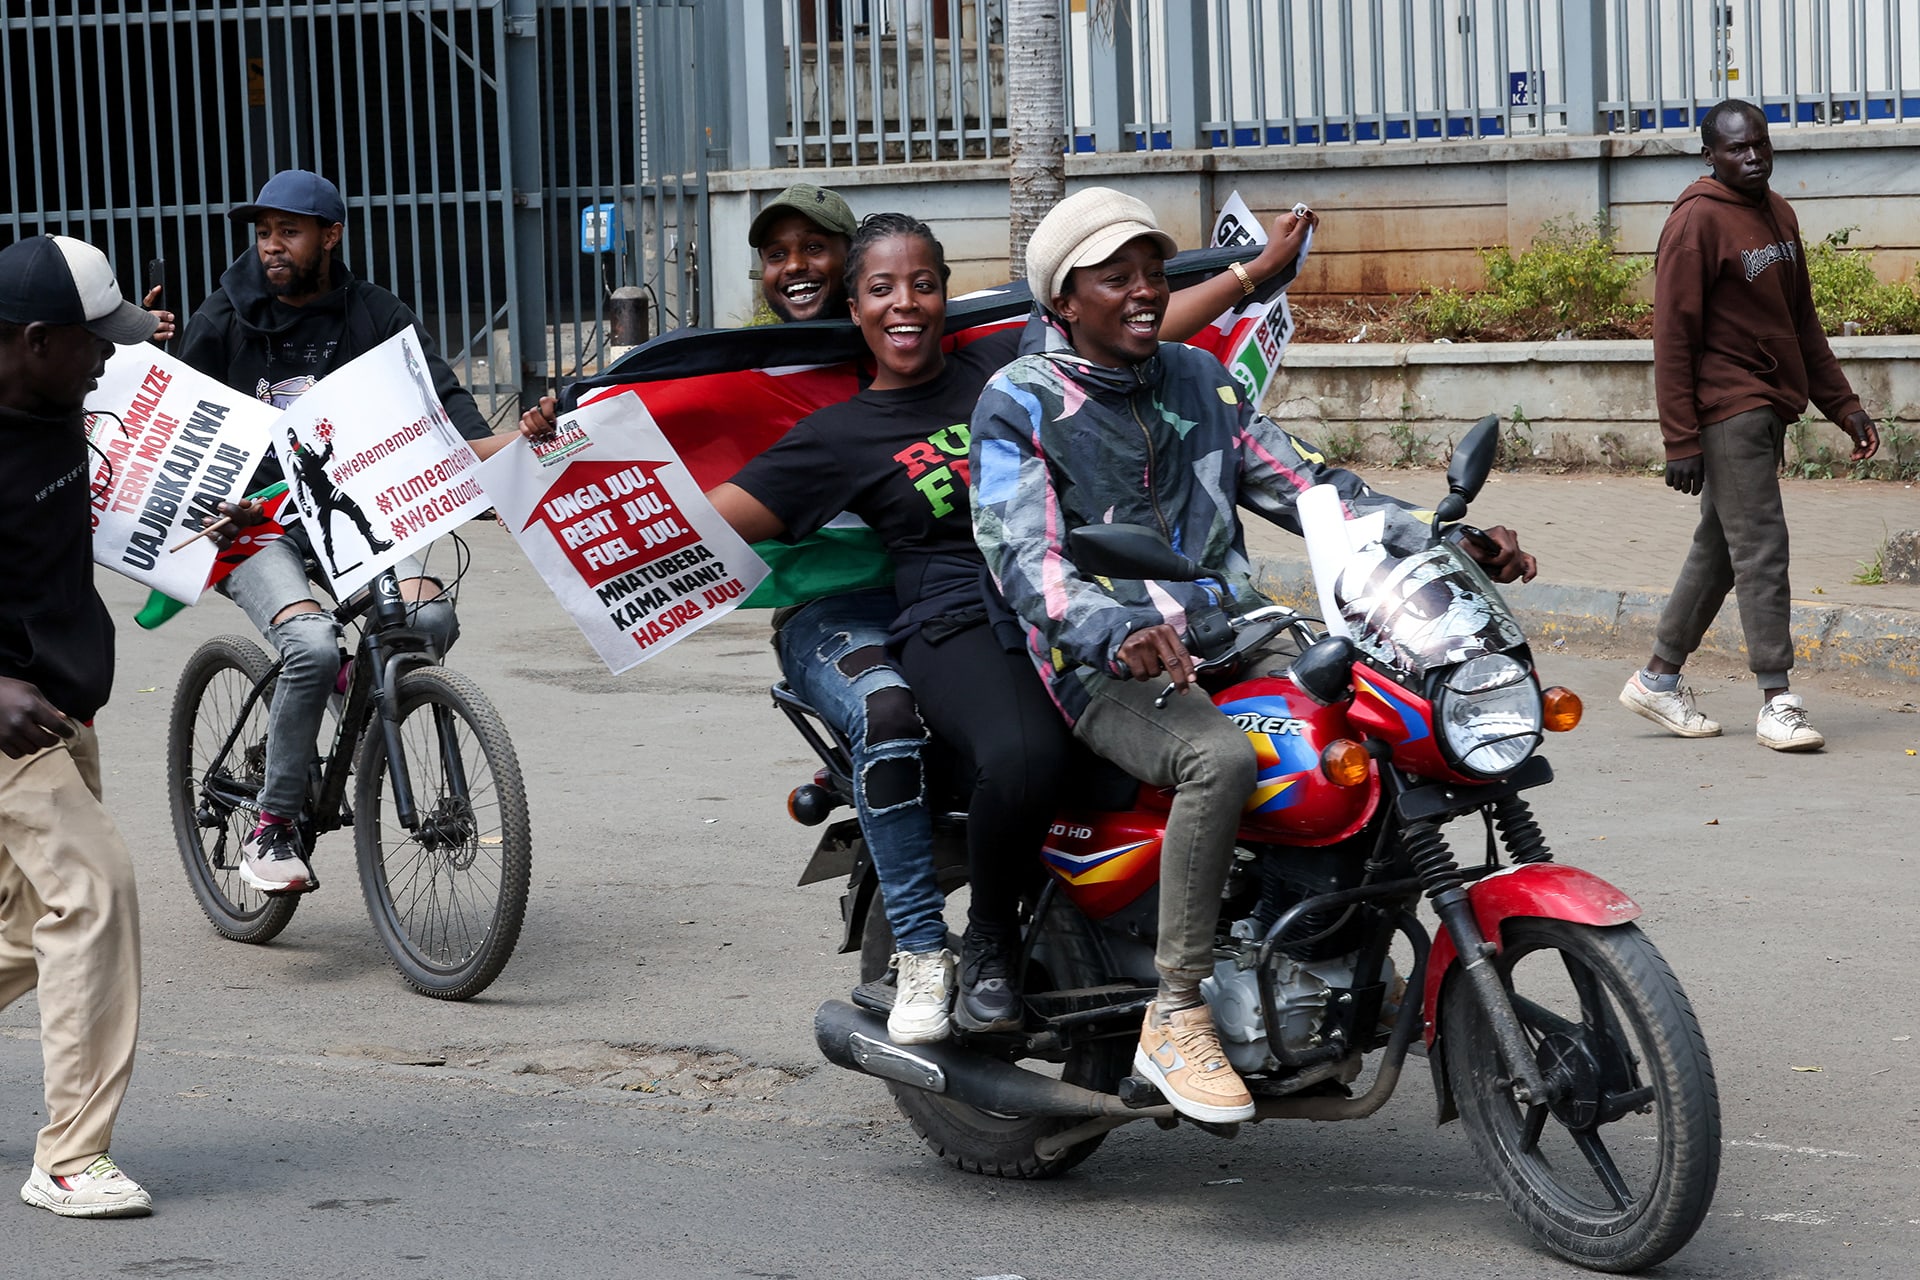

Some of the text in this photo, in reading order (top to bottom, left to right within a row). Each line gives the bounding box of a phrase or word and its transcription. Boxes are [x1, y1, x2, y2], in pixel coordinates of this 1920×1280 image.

[88, 439, 134, 512] LAZIMA
[118, 364, 173, 439] AMALIZE
[111, 412, 180, 515] TERM MOJA!
[122, 399, 231, 571] UAJIBIKAJI KWA
[181, 442, 251, 533] MAUAJI!
[543, 465, 656, 524] UNGA JUU.
[560, 491, 672, 551] RENT JUU.
[582, 517, 689, 572] FUEL JUU.
[596, 544, 715, 608] MNATUBEBA
[610, 561, 728, 632] KAMA NANI?
[631, 578, 746, 650] HASIRA JUU!
[1226, 712, 1309, 736] OXER
[1067, 826, 1092, 839] HD
